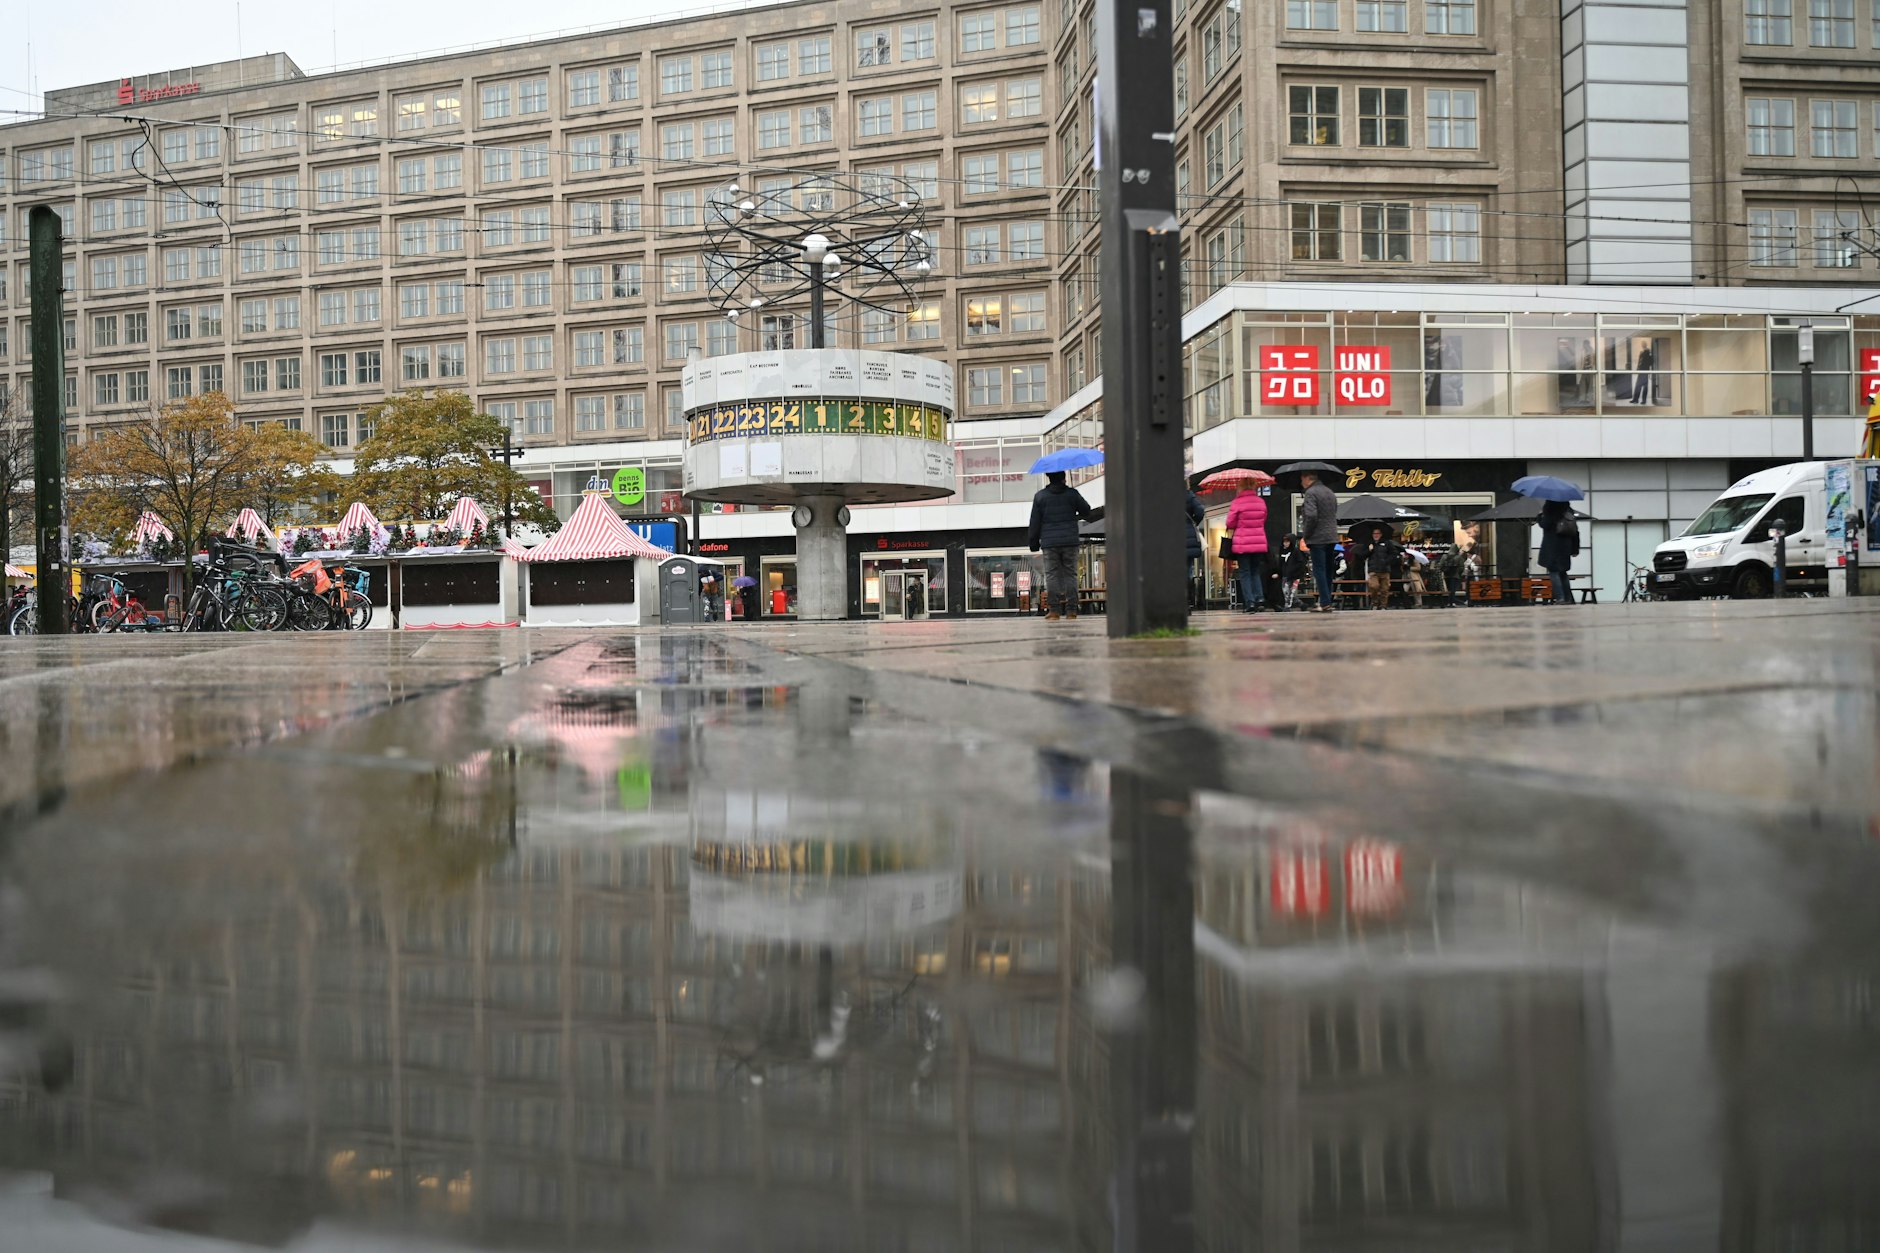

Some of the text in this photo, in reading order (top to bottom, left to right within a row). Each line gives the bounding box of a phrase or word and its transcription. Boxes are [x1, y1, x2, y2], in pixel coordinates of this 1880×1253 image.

[1269, 352, 1312, 371] ユニ
[1340, 353, 1380, 371] UNI
[1268, 378, 1312, 398] クロ
[1341, 377, 1385, 401] QLO
[697, 414, 711, 437] 21
[714, 410, 736, 433] 22
[739, 407, 766, 430] 23
[770, 406, 801, 428] 24
[814, 405, 827, 427] 1
[848, 405, 866, 428] 2
[883, 407, 896, 430] 3
[909, 410, 922, 432] 4
[931, 414, 939, 435] 5
[1371, 468, 1443, 488] Tchibo
[638, 524, 652, 542] U
[892, 540, 930, 550] Sparkasse
